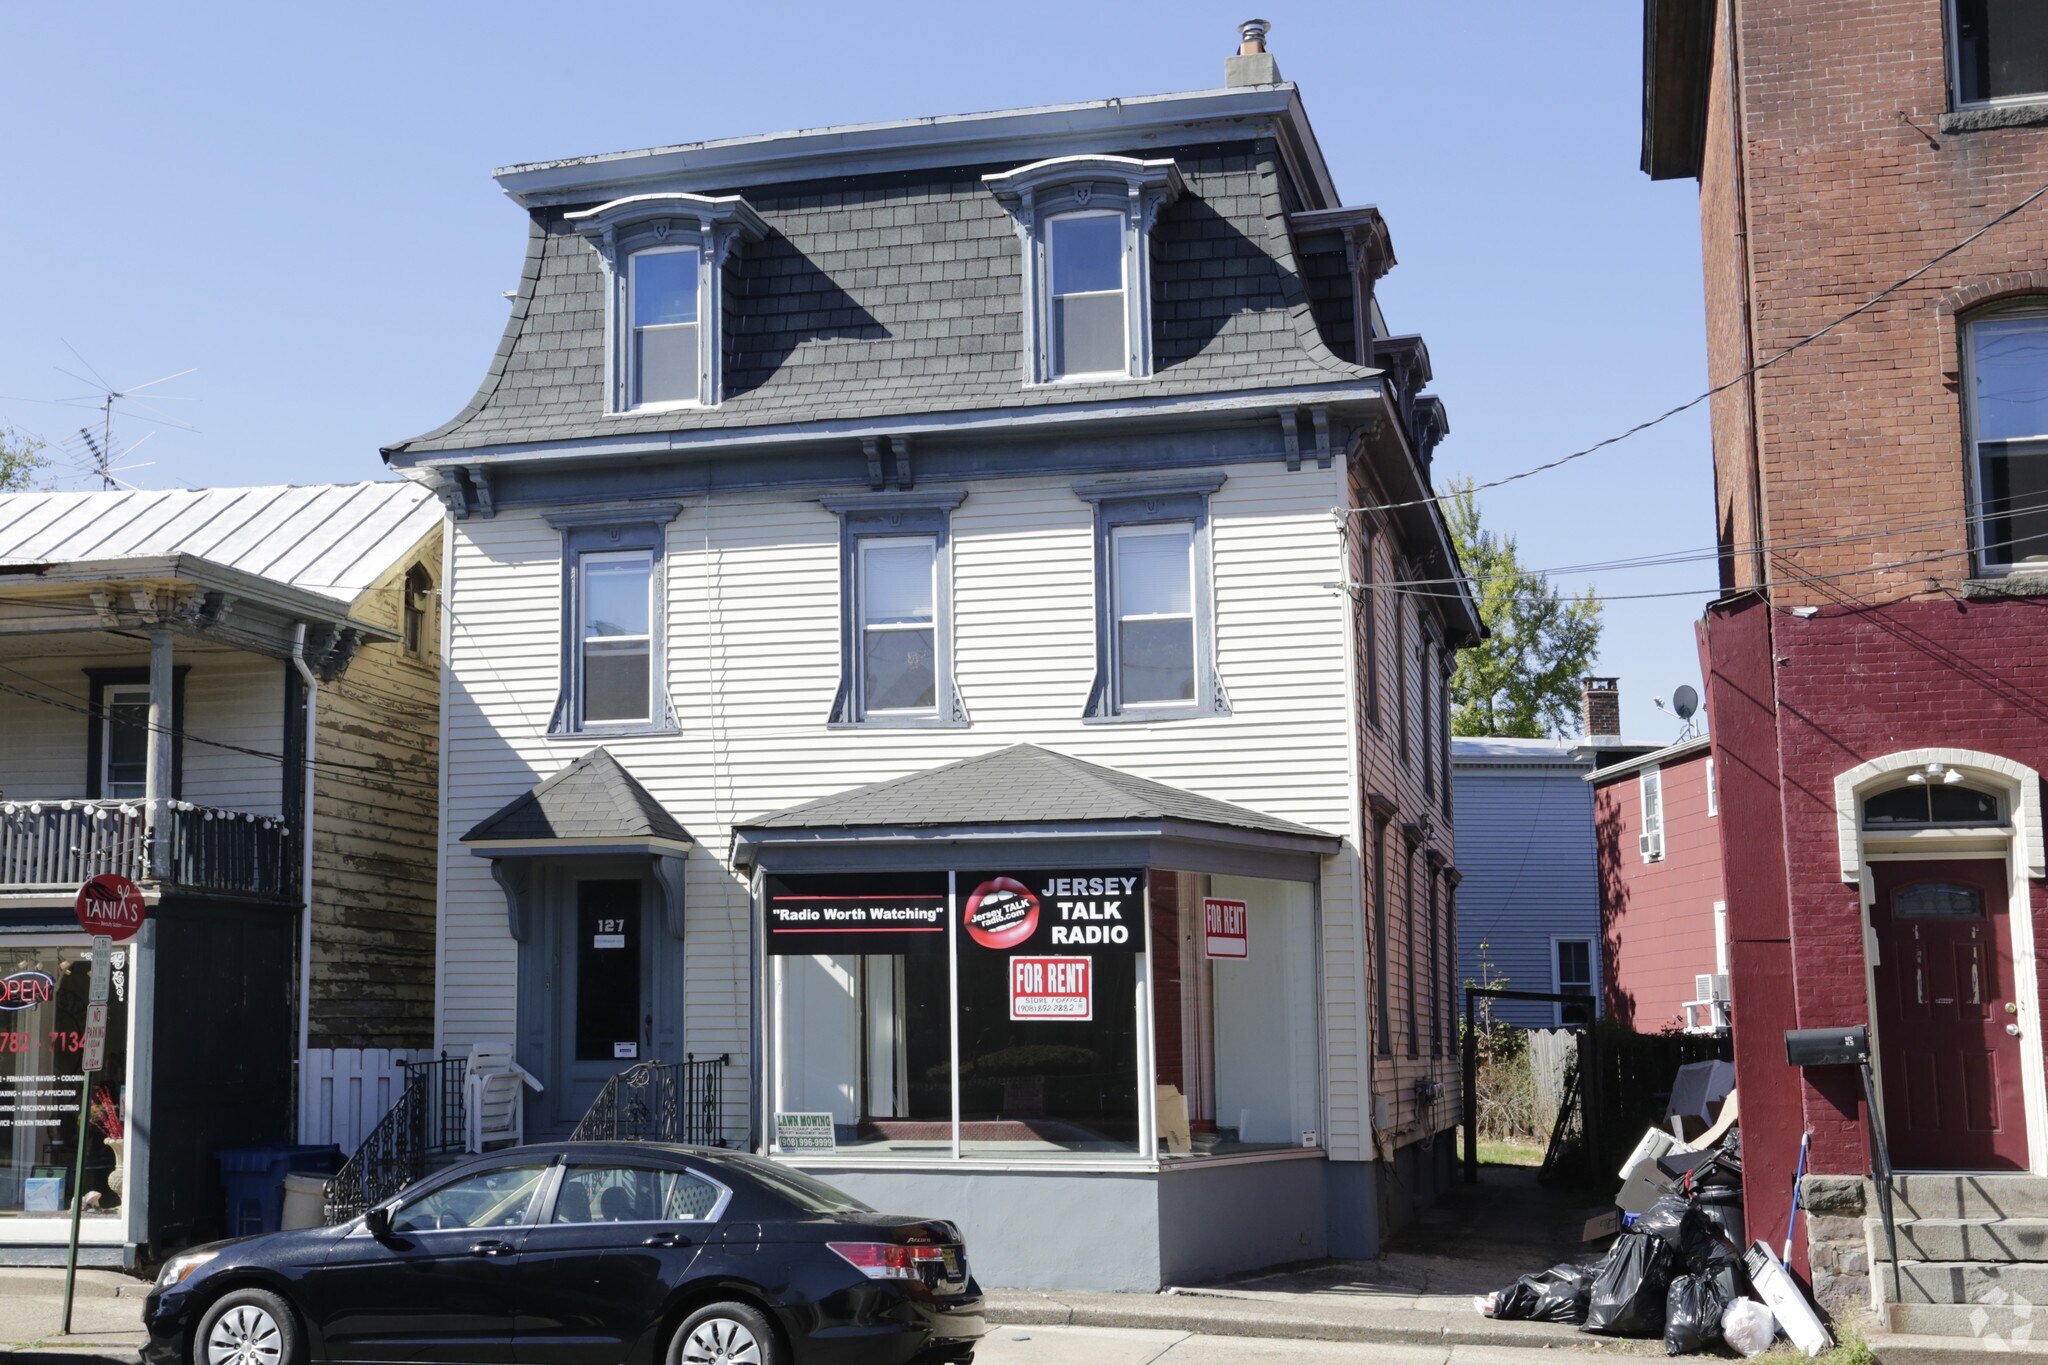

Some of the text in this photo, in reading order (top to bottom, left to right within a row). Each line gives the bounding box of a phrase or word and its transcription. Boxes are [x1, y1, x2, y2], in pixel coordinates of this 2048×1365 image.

[1041, 877, 1137, 896] JERSEY
[85, 885, 138, 922] TANIA'S
[971, 898, 1030, 923] Jersey TALK
[1057, 901, 1122, 920] TALK
[773, 908, 943, 922] "Radio Worth Watching"
[981, 909, 1025, 927] radio.com
[1206, 903, 1244, 935] FOR RENT
[598, 919, 624, 932] 127
[1052, 925, 1129, 944] RADIO
[1016, 963, 1085, 993] FOR RENT
[93, 1010, 101, 1022] NO
[0, 1032, 30, 1052] 782
[87, 1026, 105, 1039] PARKING
[777, 1115, 831, 1127] LAWN MOWING
[780, 1137, 833, 1148] (908) 996-9999
